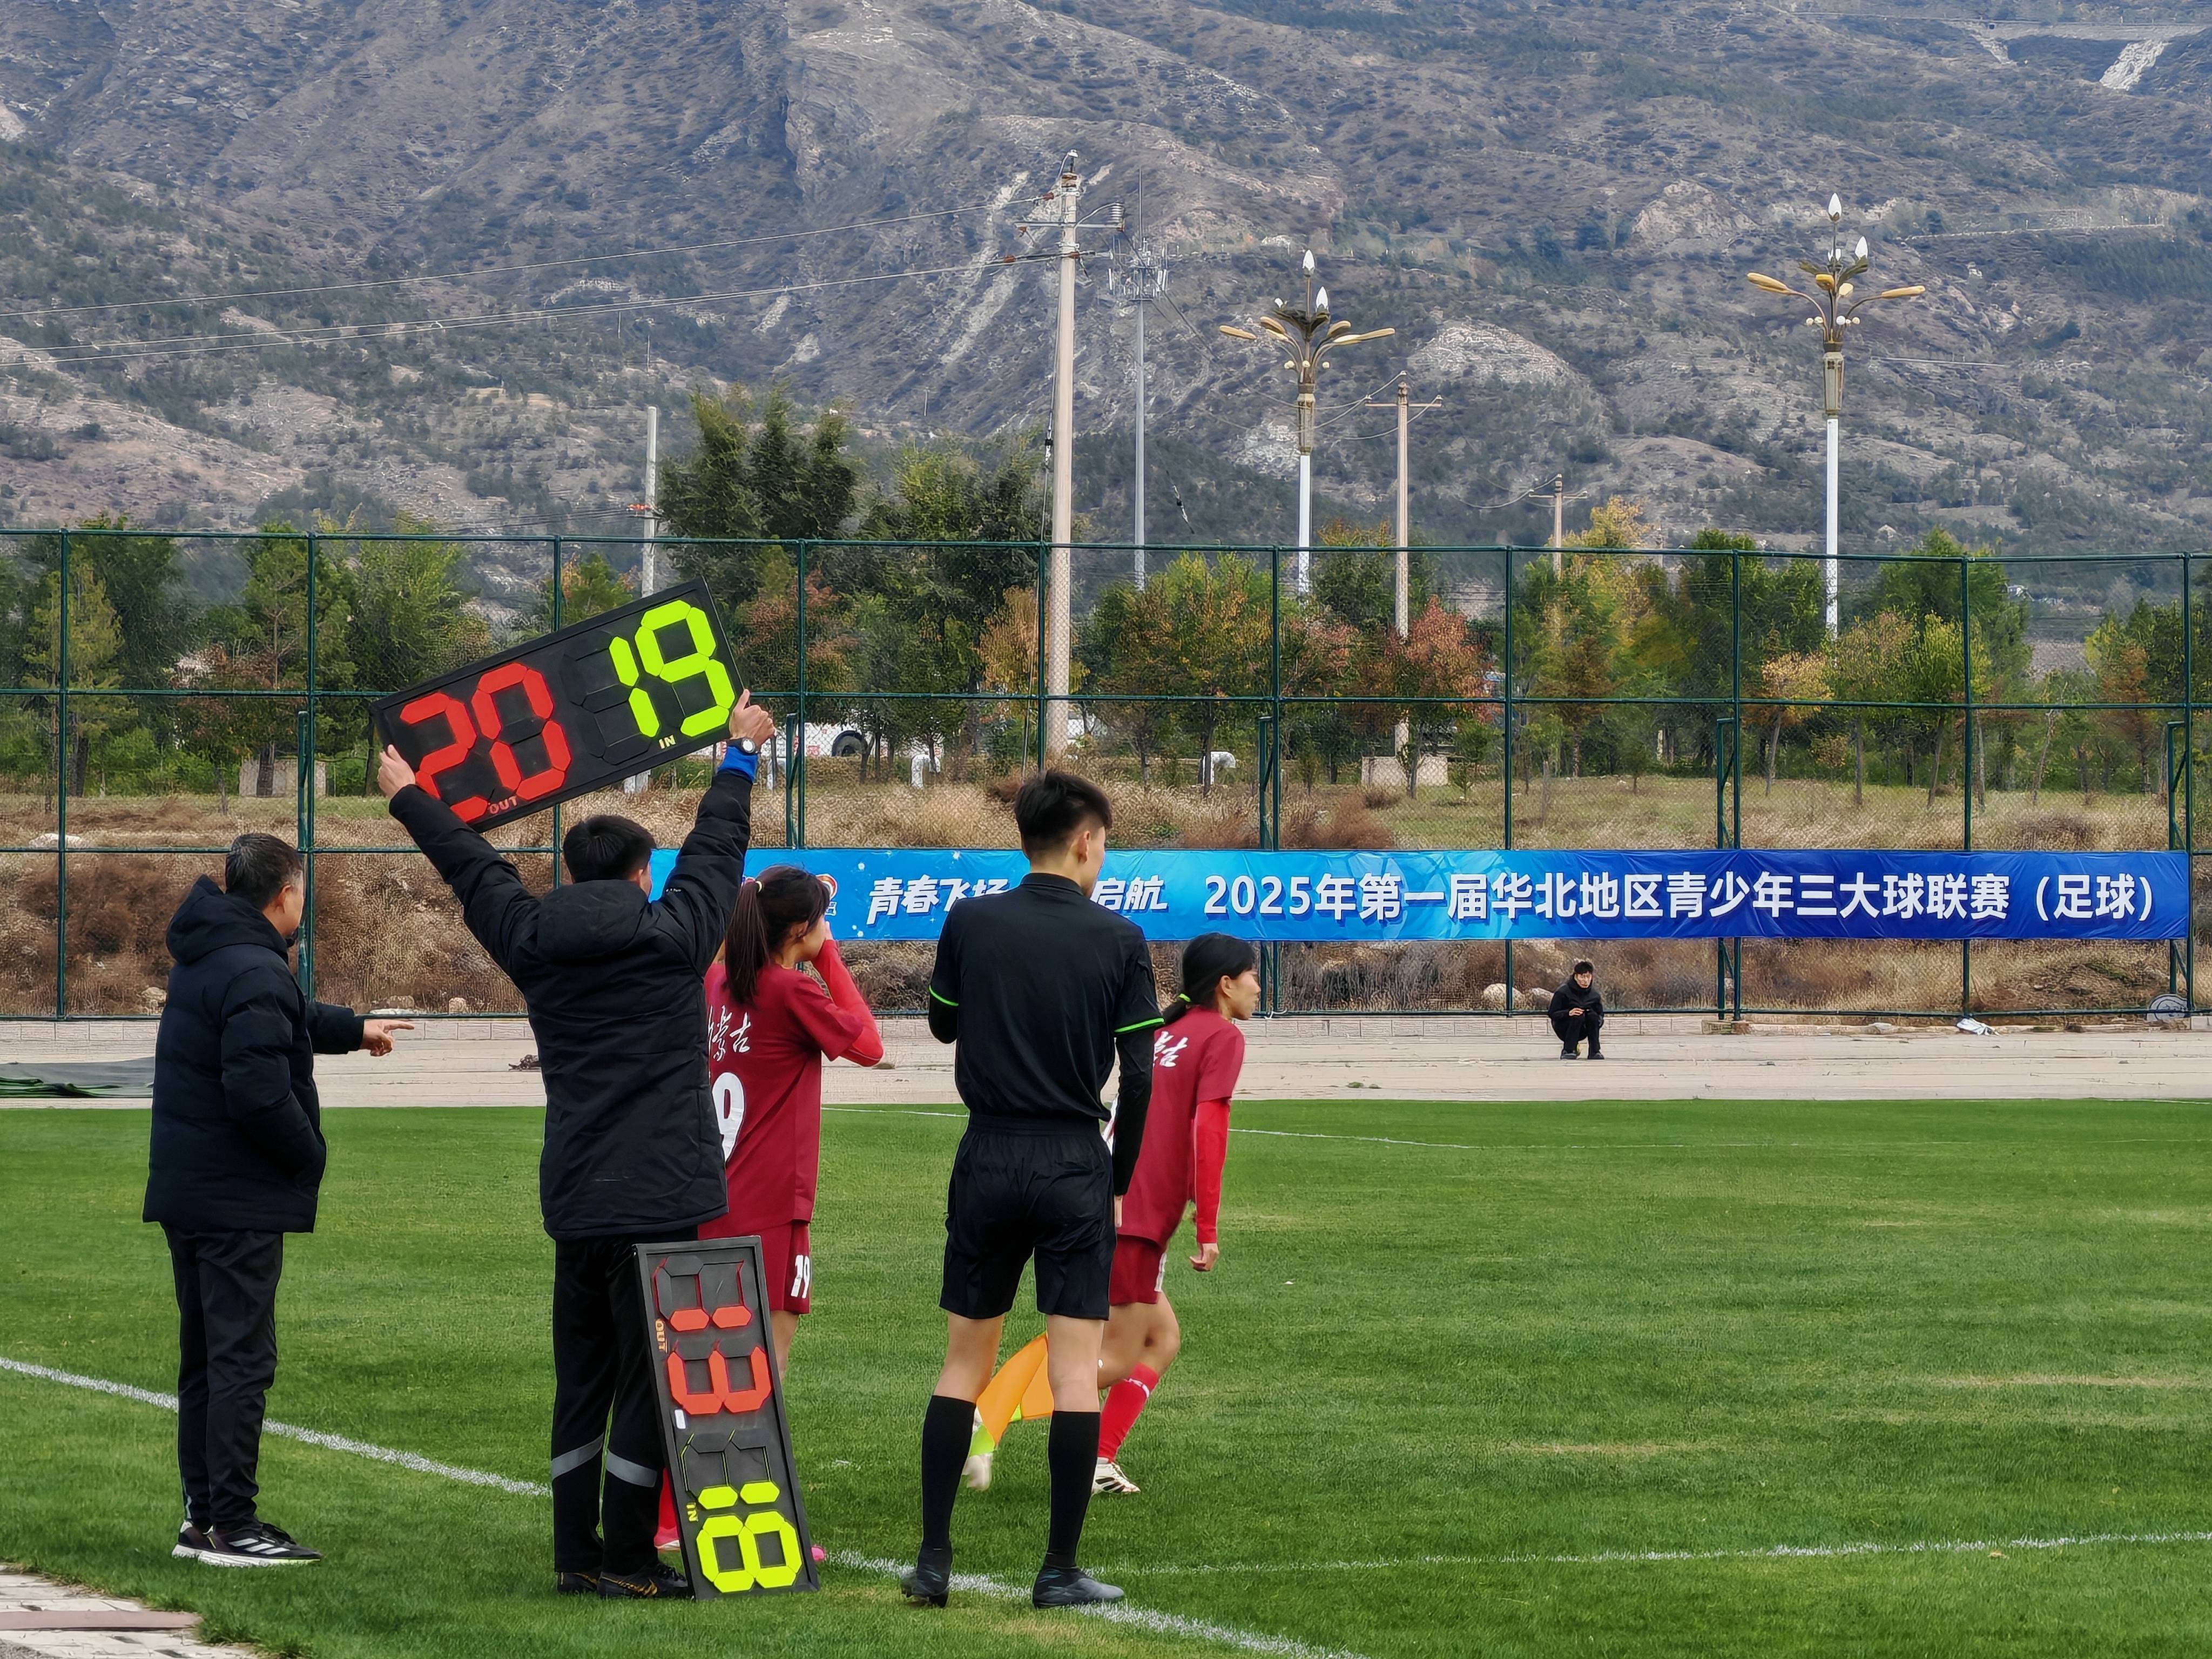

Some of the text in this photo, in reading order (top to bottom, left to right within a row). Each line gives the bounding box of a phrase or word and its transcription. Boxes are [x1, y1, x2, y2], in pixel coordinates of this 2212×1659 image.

[400, 600, 735, 822] 20 19
[489, 734, 676, 814] OUT IN
[1204, 872, 2153, 921] 2025年第一届华北地区青少年三大球联赛（足球）
[709, 1071, 745, 1163] 9
[790, 1254, 811, 1299] 19
[655, 1318, 698, 1522] OUT IN
